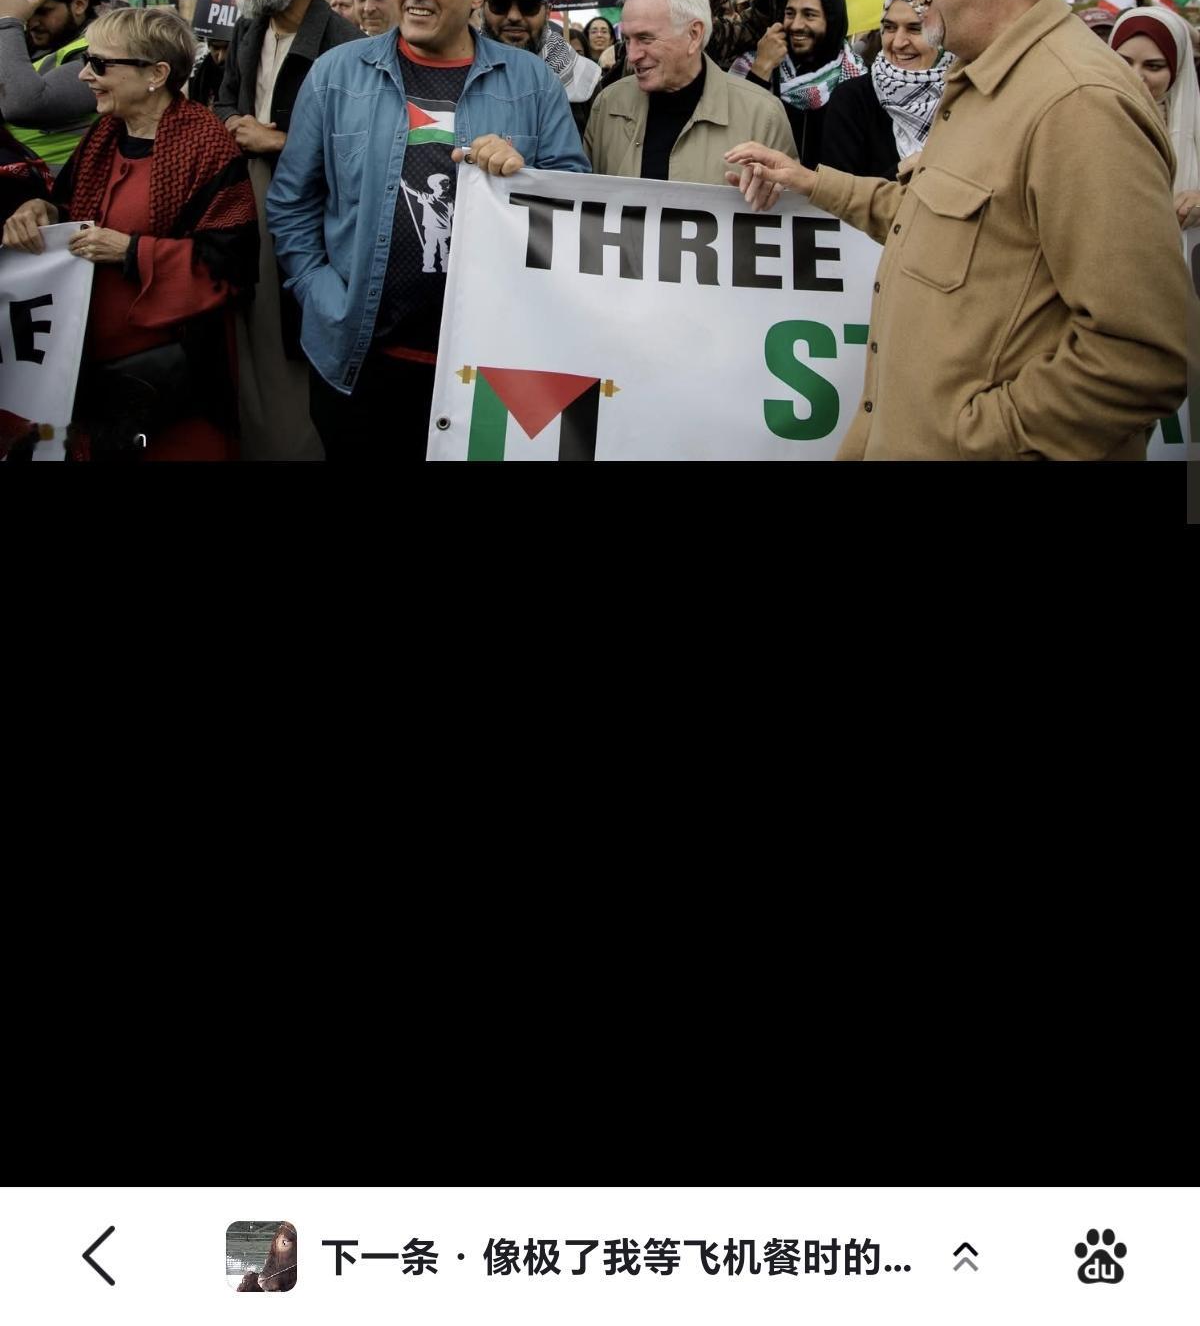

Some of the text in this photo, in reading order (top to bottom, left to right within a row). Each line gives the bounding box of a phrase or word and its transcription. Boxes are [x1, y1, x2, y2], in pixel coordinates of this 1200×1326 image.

[509, 192, 844, 293] THREE
[320, 1236, 440, 1277] 下一条
[1084, 1258, 1115, 1279] du
